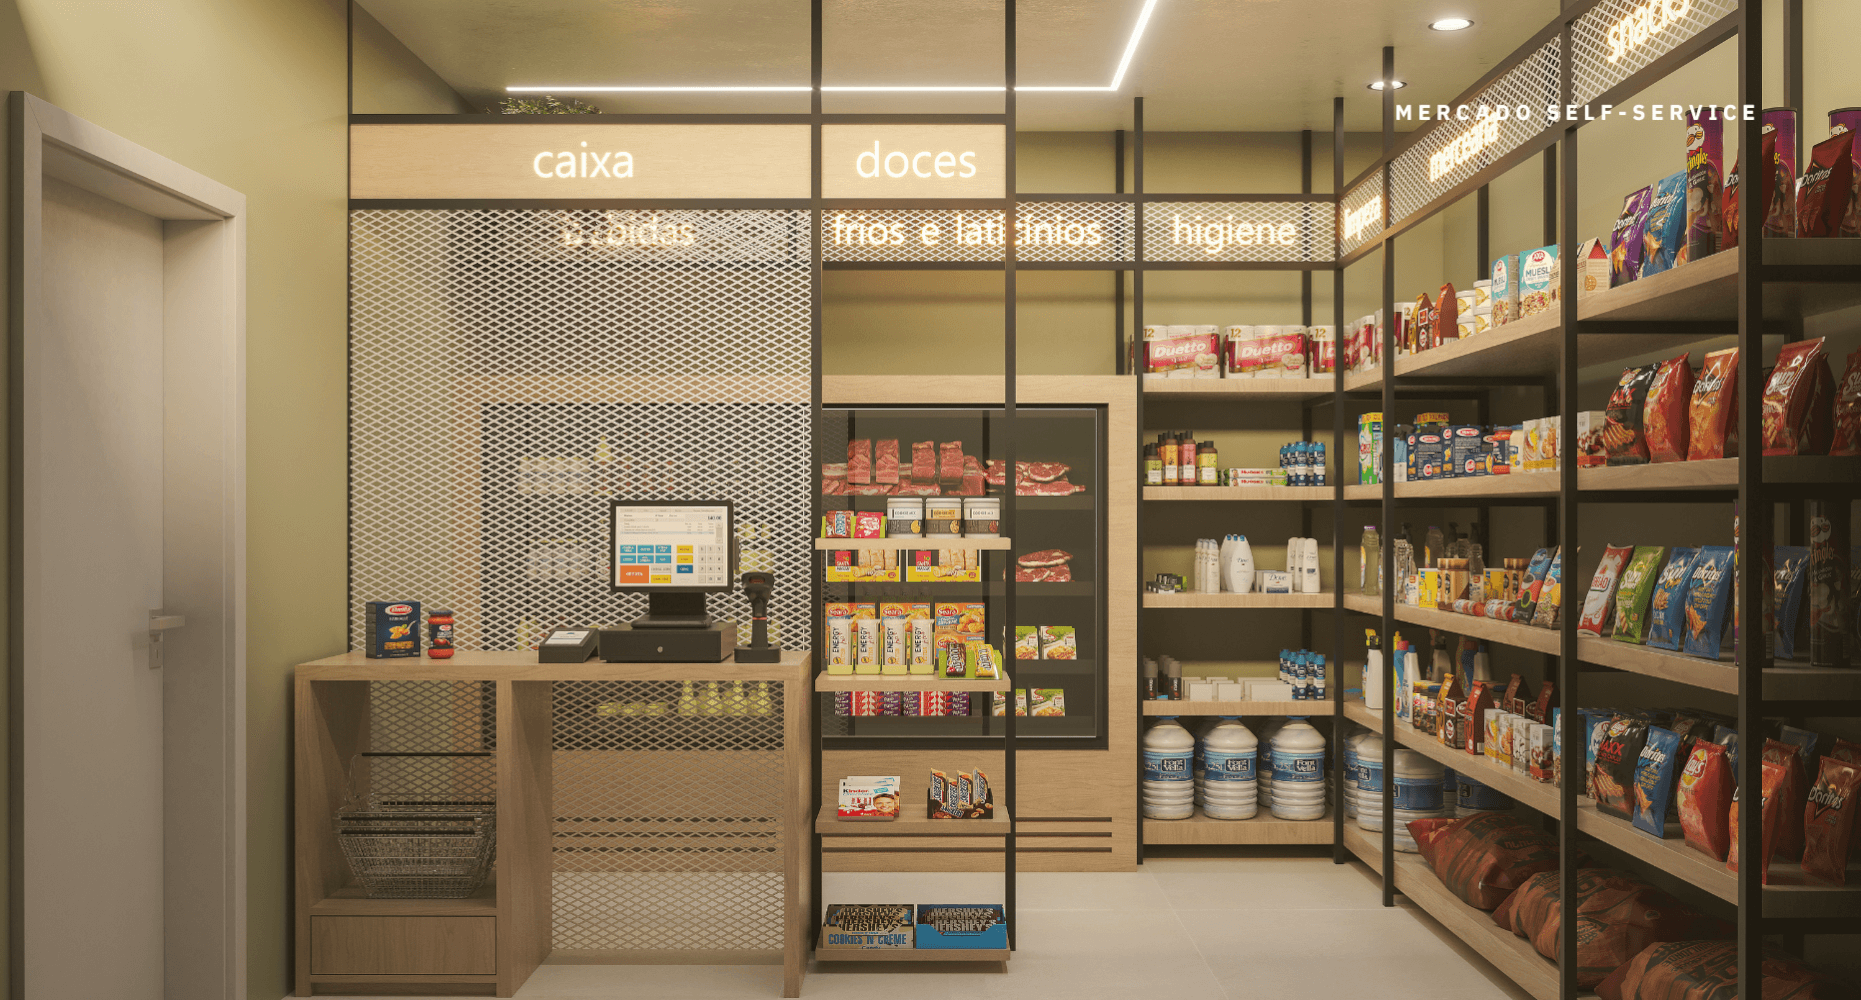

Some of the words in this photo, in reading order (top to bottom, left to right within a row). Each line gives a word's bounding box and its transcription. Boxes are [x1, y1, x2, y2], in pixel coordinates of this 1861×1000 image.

[532, 141, 634, 179] caixa
[855, 140, 977, 179] doces
[831, 213, 905, 246] frios
[921, 222, 940, 246] e
[1173, 213, 1297, 254] higiene
[1229, 328, 1242, 338] 12
[1314, 328, 1327, 338] 12
[1154, 342, 1207, 358] Duetto
[1241, 342, 1293, 358] Duetto
[1269, 573, 1287, 581] Dove
[938, 608, 957, 616] Seara
[832, 627, 840, 653] ENERGY
[860, 627, 868, 653] ENERGY
[886, 627, 894, 653] ENERGY
[914, 627, 922, 653] ENERGY
[828, 933, 863, 945] COOKIES
[877, 933, 907, 945] CREME
